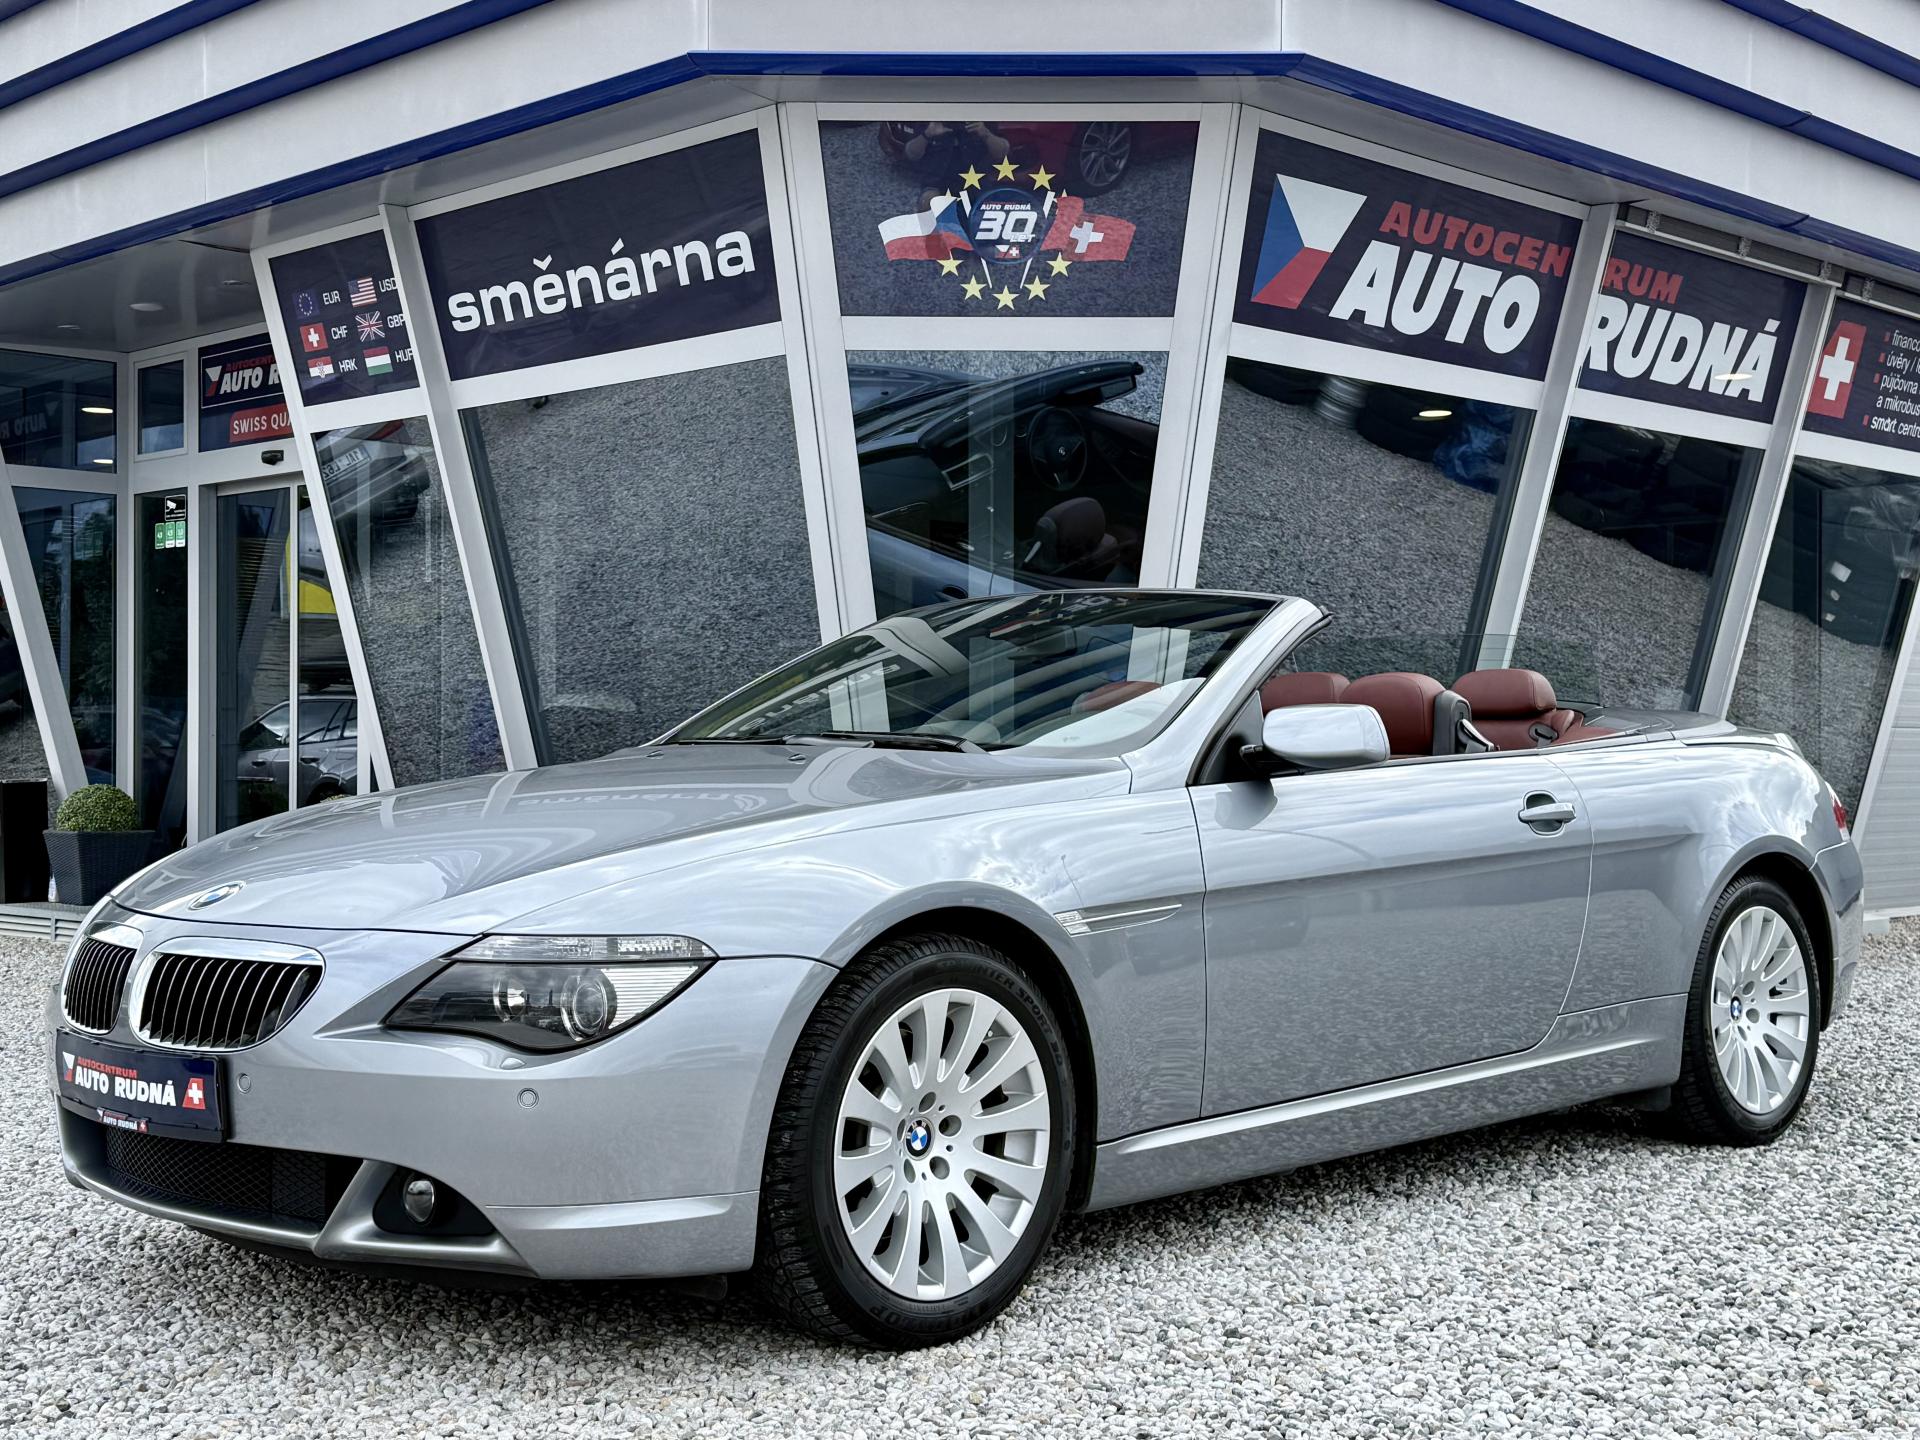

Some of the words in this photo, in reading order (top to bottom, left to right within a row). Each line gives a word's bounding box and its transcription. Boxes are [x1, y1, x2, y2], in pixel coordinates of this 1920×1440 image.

[980, 203, 1002, 211] AUTO
[975, 210, 1038, 240] 30
[1379, 200, 1572, 277] AUTOCEN
[1603, 257, 1684, 304] RUM
[379, 277, 397, 293] USD
[448, 230, 756, 332] směnárna
[322, 290, 341, 305] EUR
[386, 313, 405, 329] GBP
[1328, 239, 1541, 354] AUTO
[1581, 293, 1781, 403] RUDNÁ
[330, 325, 348, 340] CHF
[394, 347, 414, 363] HUF
[1886, 350, 1910, 375] úvěry
[338, 358, 359, 373] HRK
[219, 366, 264, 395] AUTO
[268, 363, 280, 385] R
[1876, 395, 1883, 408] a
[232, 415, 268, 435] SWISS
[77, 1055, 138, 1079] AUTOCENTRUM
[74, 1065, 110, 1095] AUTO
[114, 1076, 177, 1107] RUDNÁ
